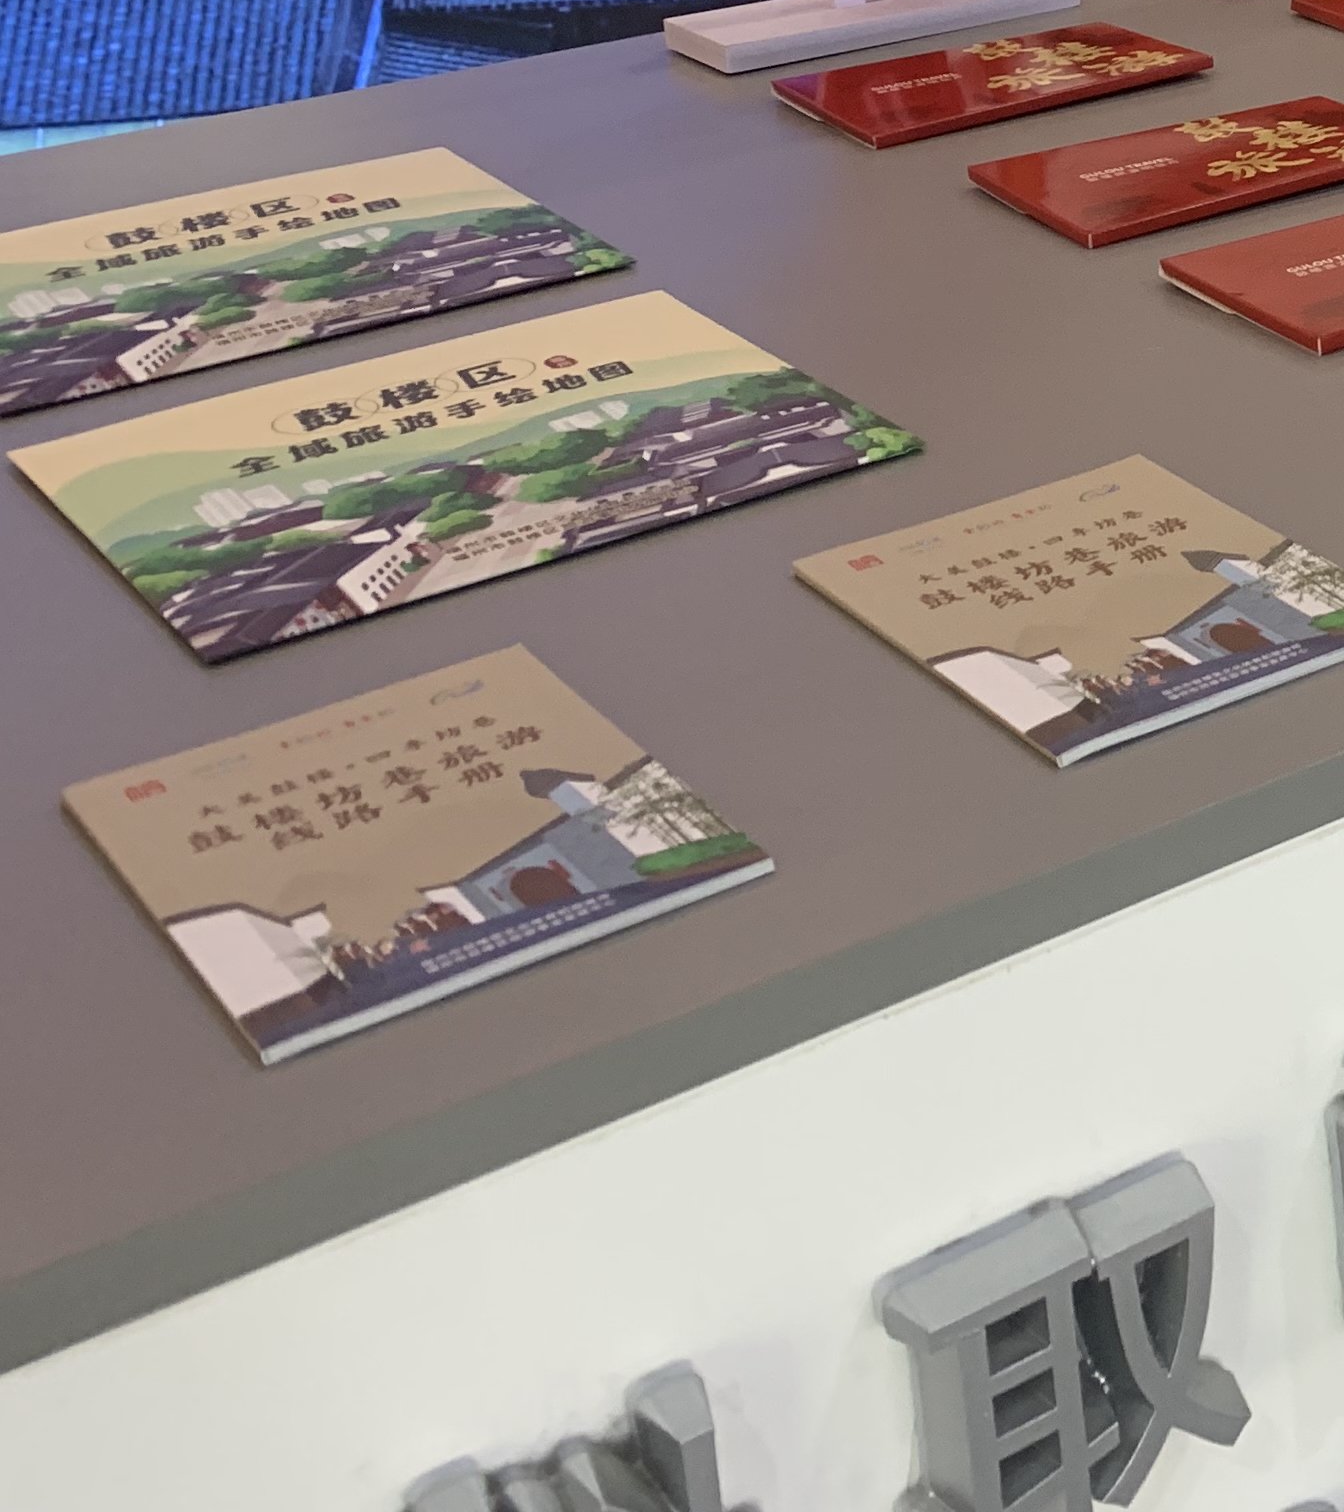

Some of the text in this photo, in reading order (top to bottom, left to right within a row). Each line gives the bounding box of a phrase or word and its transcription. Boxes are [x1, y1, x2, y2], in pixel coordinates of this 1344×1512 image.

[45, 197, 401, 284] 全域旅游手绘地图
[105, 196, 301, 250] 鼓楼区
[229, 360, 633, 479] 全域旅游手绘地图
[297, 360, 516, 435] 鼓楼区
[919, 517, 1188, 609] 鼓楼坊巷旅游
[990, 543, 1168, 609] 线路手册
